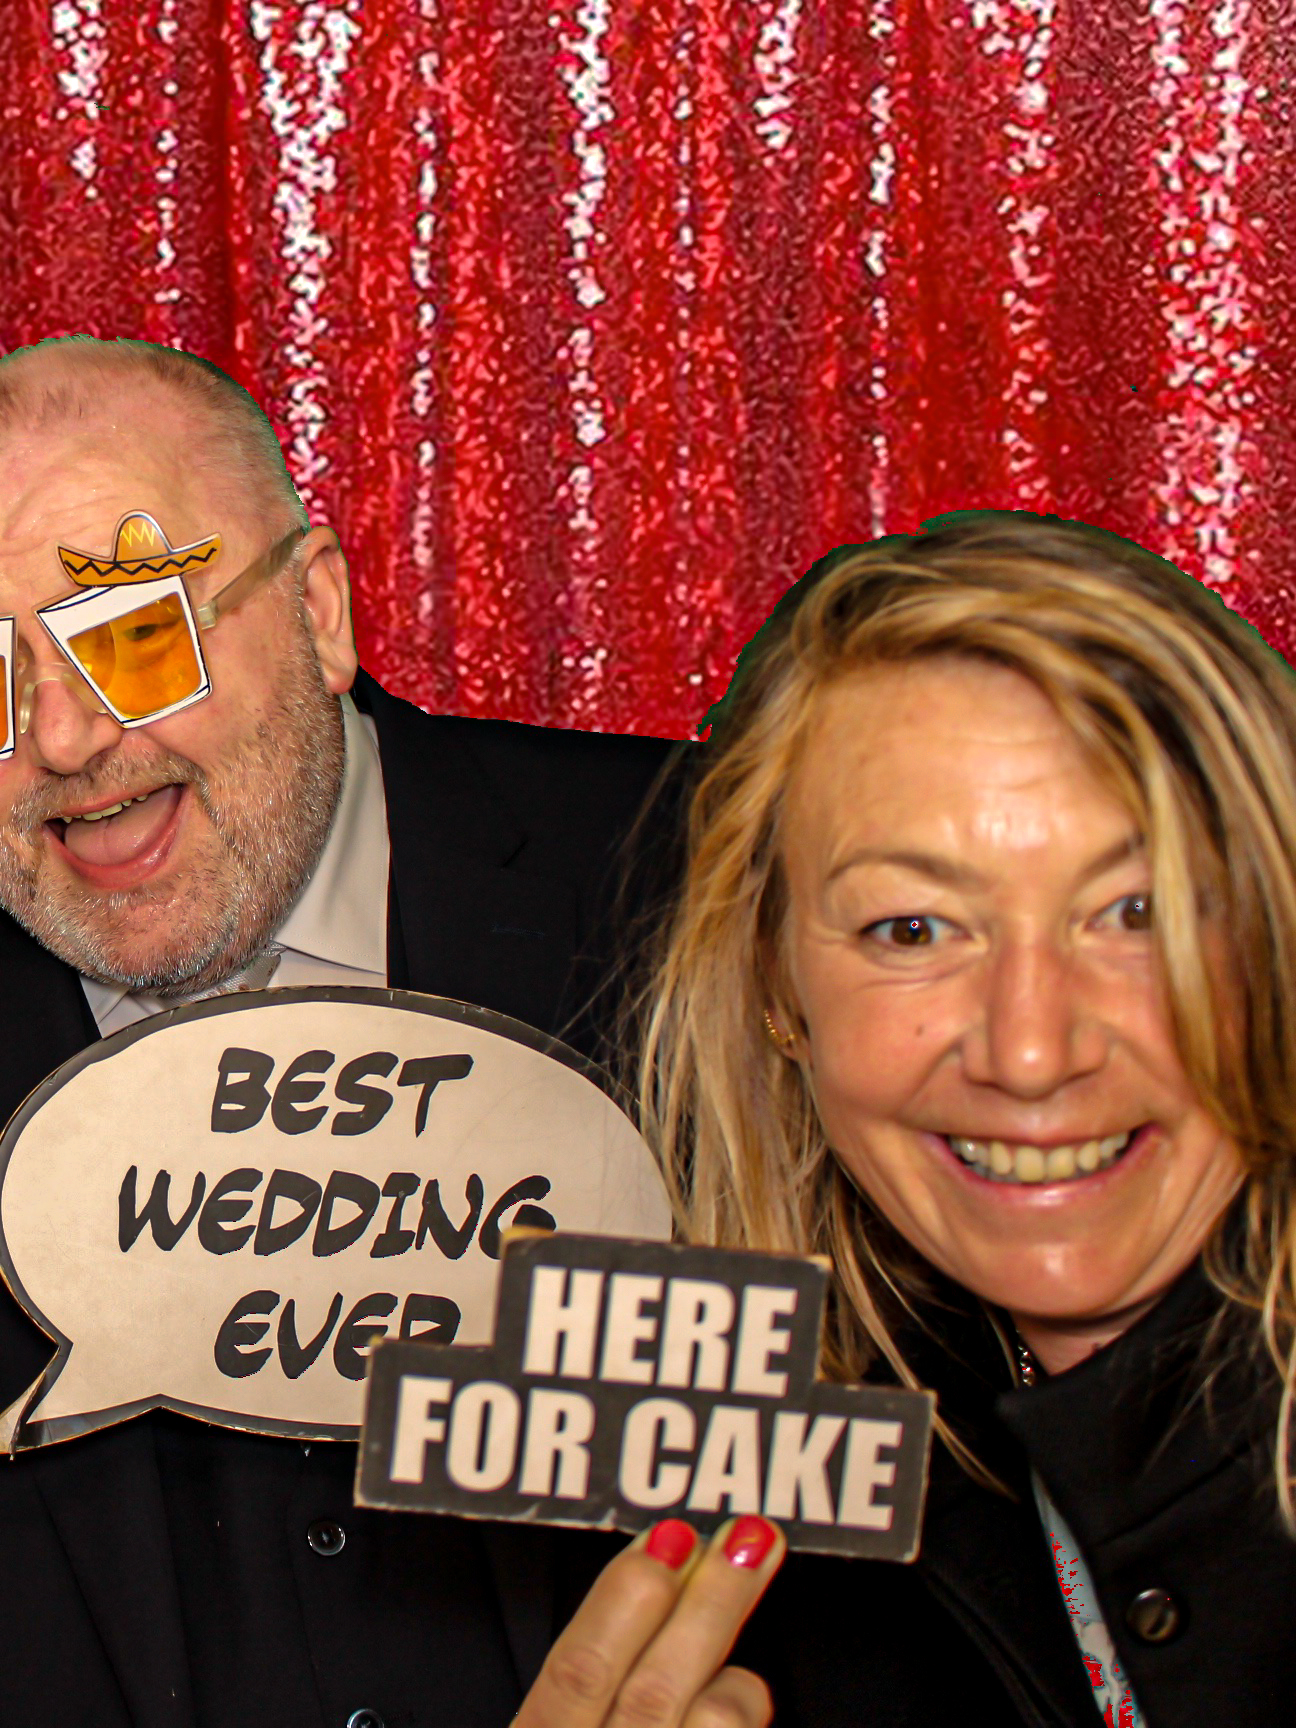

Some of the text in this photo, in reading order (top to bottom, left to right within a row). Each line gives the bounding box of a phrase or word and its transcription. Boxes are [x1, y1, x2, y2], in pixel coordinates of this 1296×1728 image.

[210, 1046, 474, 1137] BEST
[522, 1264, 798, 1397] HERE
[389, 1373, 904, 1532] FOR CAKE
